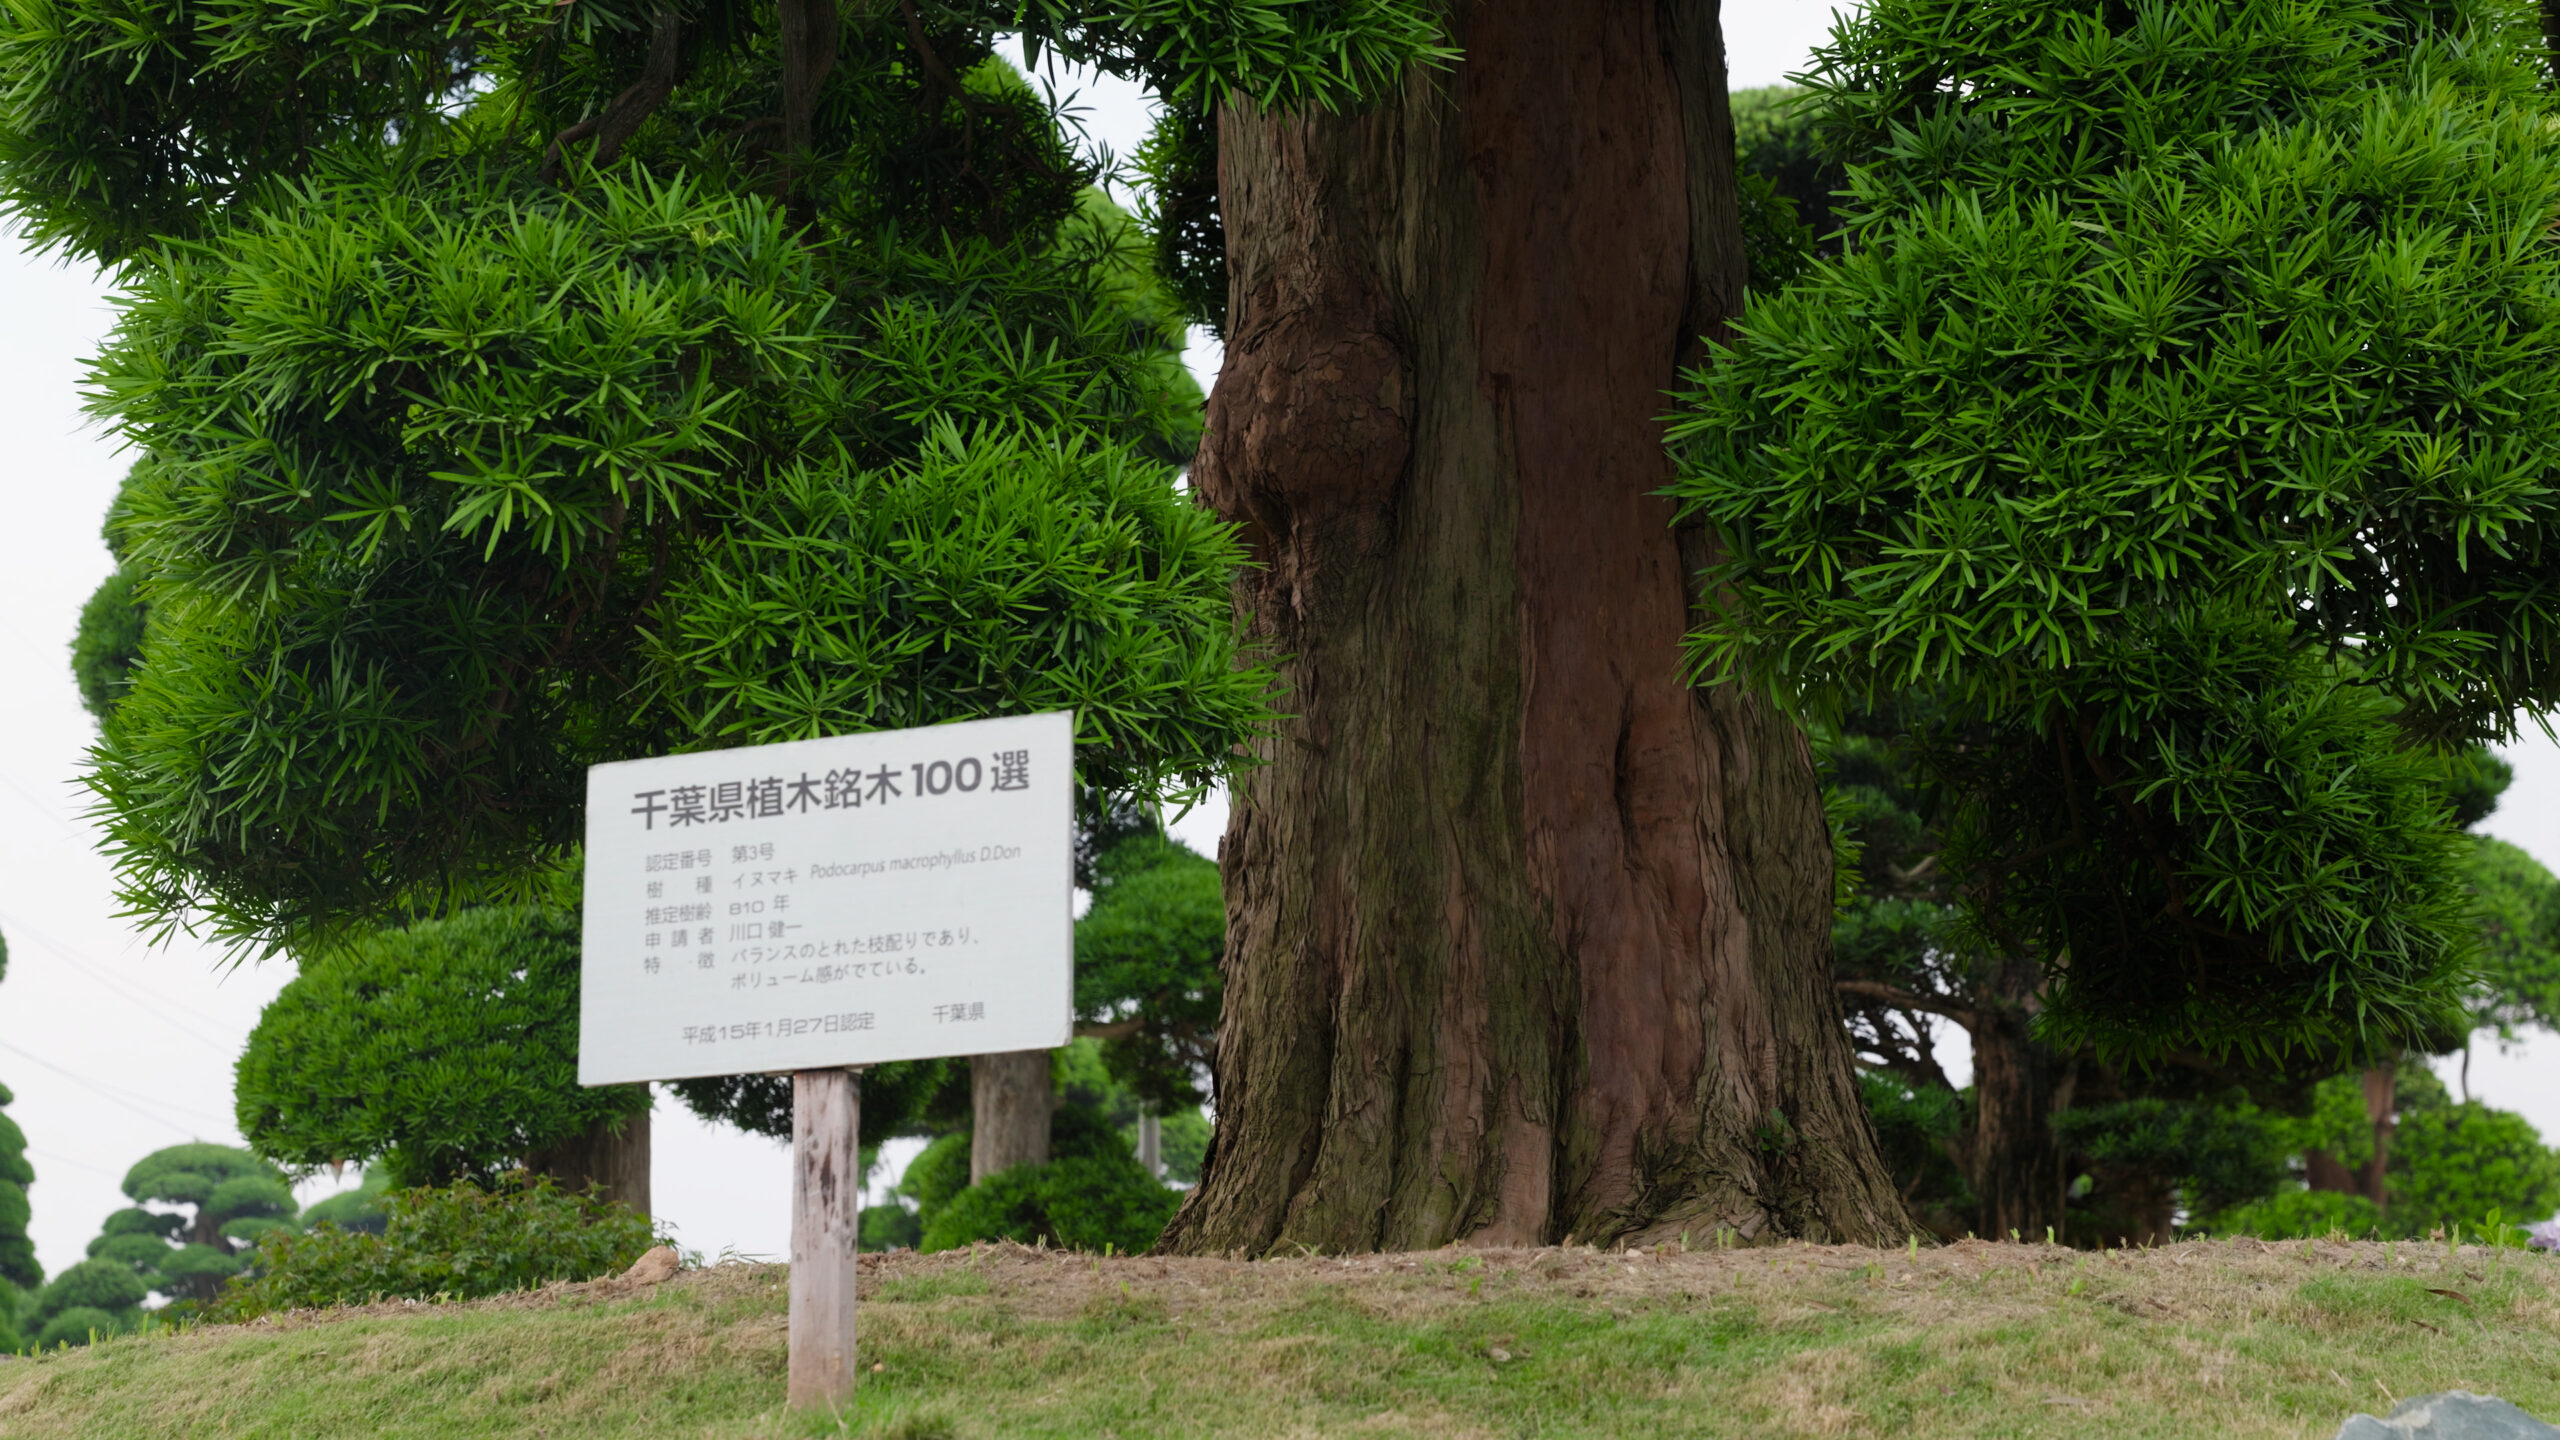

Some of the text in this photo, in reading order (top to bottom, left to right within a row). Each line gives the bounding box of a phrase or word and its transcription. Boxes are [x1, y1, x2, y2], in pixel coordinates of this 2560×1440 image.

[630, 748, 1031, 831] 千葉県植木銘木100選
[645, 842, 775, 872] 認定番号 第3号
[733, 868, 798, 889] イヌマキ
[811, 861, 886, 879] Podocarpus
[889, 849, 977, 870] macrophyllus
[980, 844, 1022, 862] D.Don
[645, 903, 712, 926] 推定樹齢
[732, 926, 979, 964] バランスのとれた枝配りであり、
[732, 956, 926, 991] ボリューム感がでている。
[682, 1012, 876, 1045] 平成15年1月27日認定
[932, 1001, 986, 1024] 千葉県
